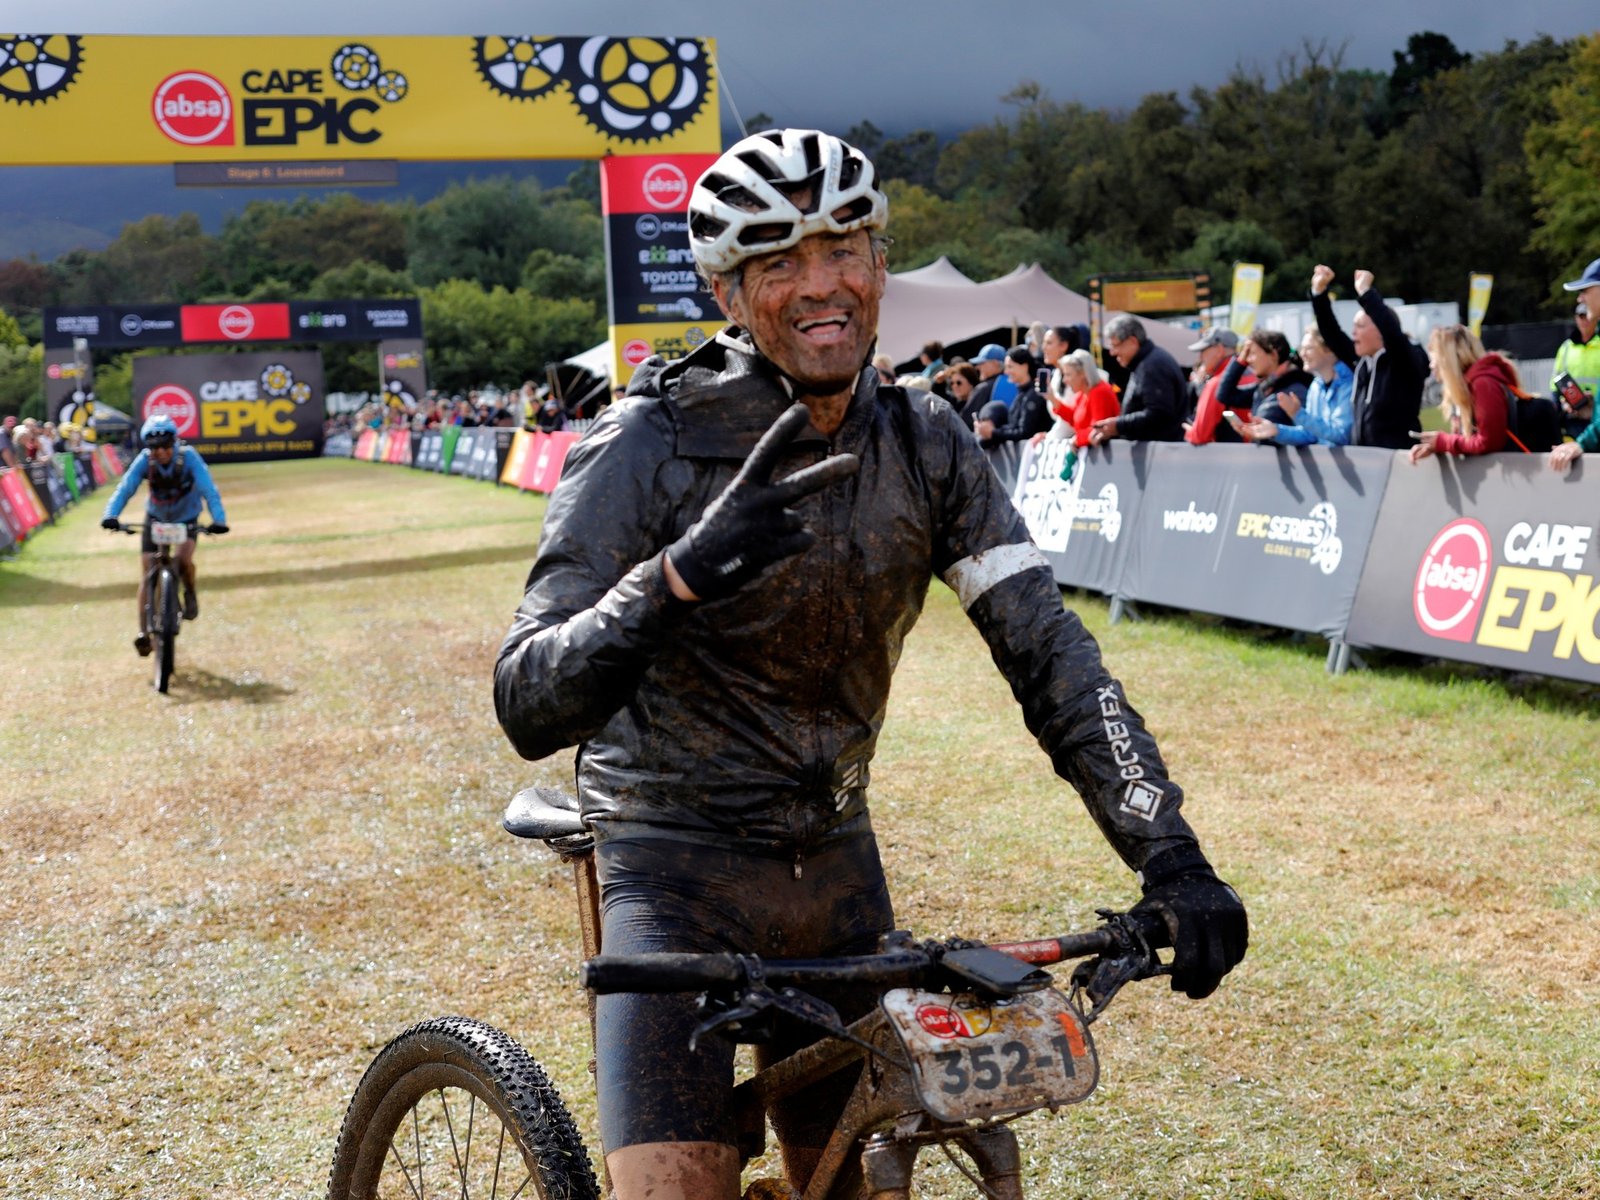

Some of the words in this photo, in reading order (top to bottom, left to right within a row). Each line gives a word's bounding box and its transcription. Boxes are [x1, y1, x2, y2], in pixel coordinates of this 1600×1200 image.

[241, 69, 323, 93] CAPE
[164, 94, 223, 117] absa
[242, 97, 382, 146] EPIC
[648, 175, 682, 192] absa
[640, 271, 697, 284] TOYOTA
[366, 310, 408, 321] TOYOTA
[200, 380, 258, 400] CAPE
[152, 401, 189, 415] absa
[201, 399, 297, 438] EPIC
[1163, 501, 1218, 534] wahoo
[1504, 521, 1592, 570] CAPE
[1426, 553, 1479, 592] absa
[934, 1034, 1076, 1095] 352-1
